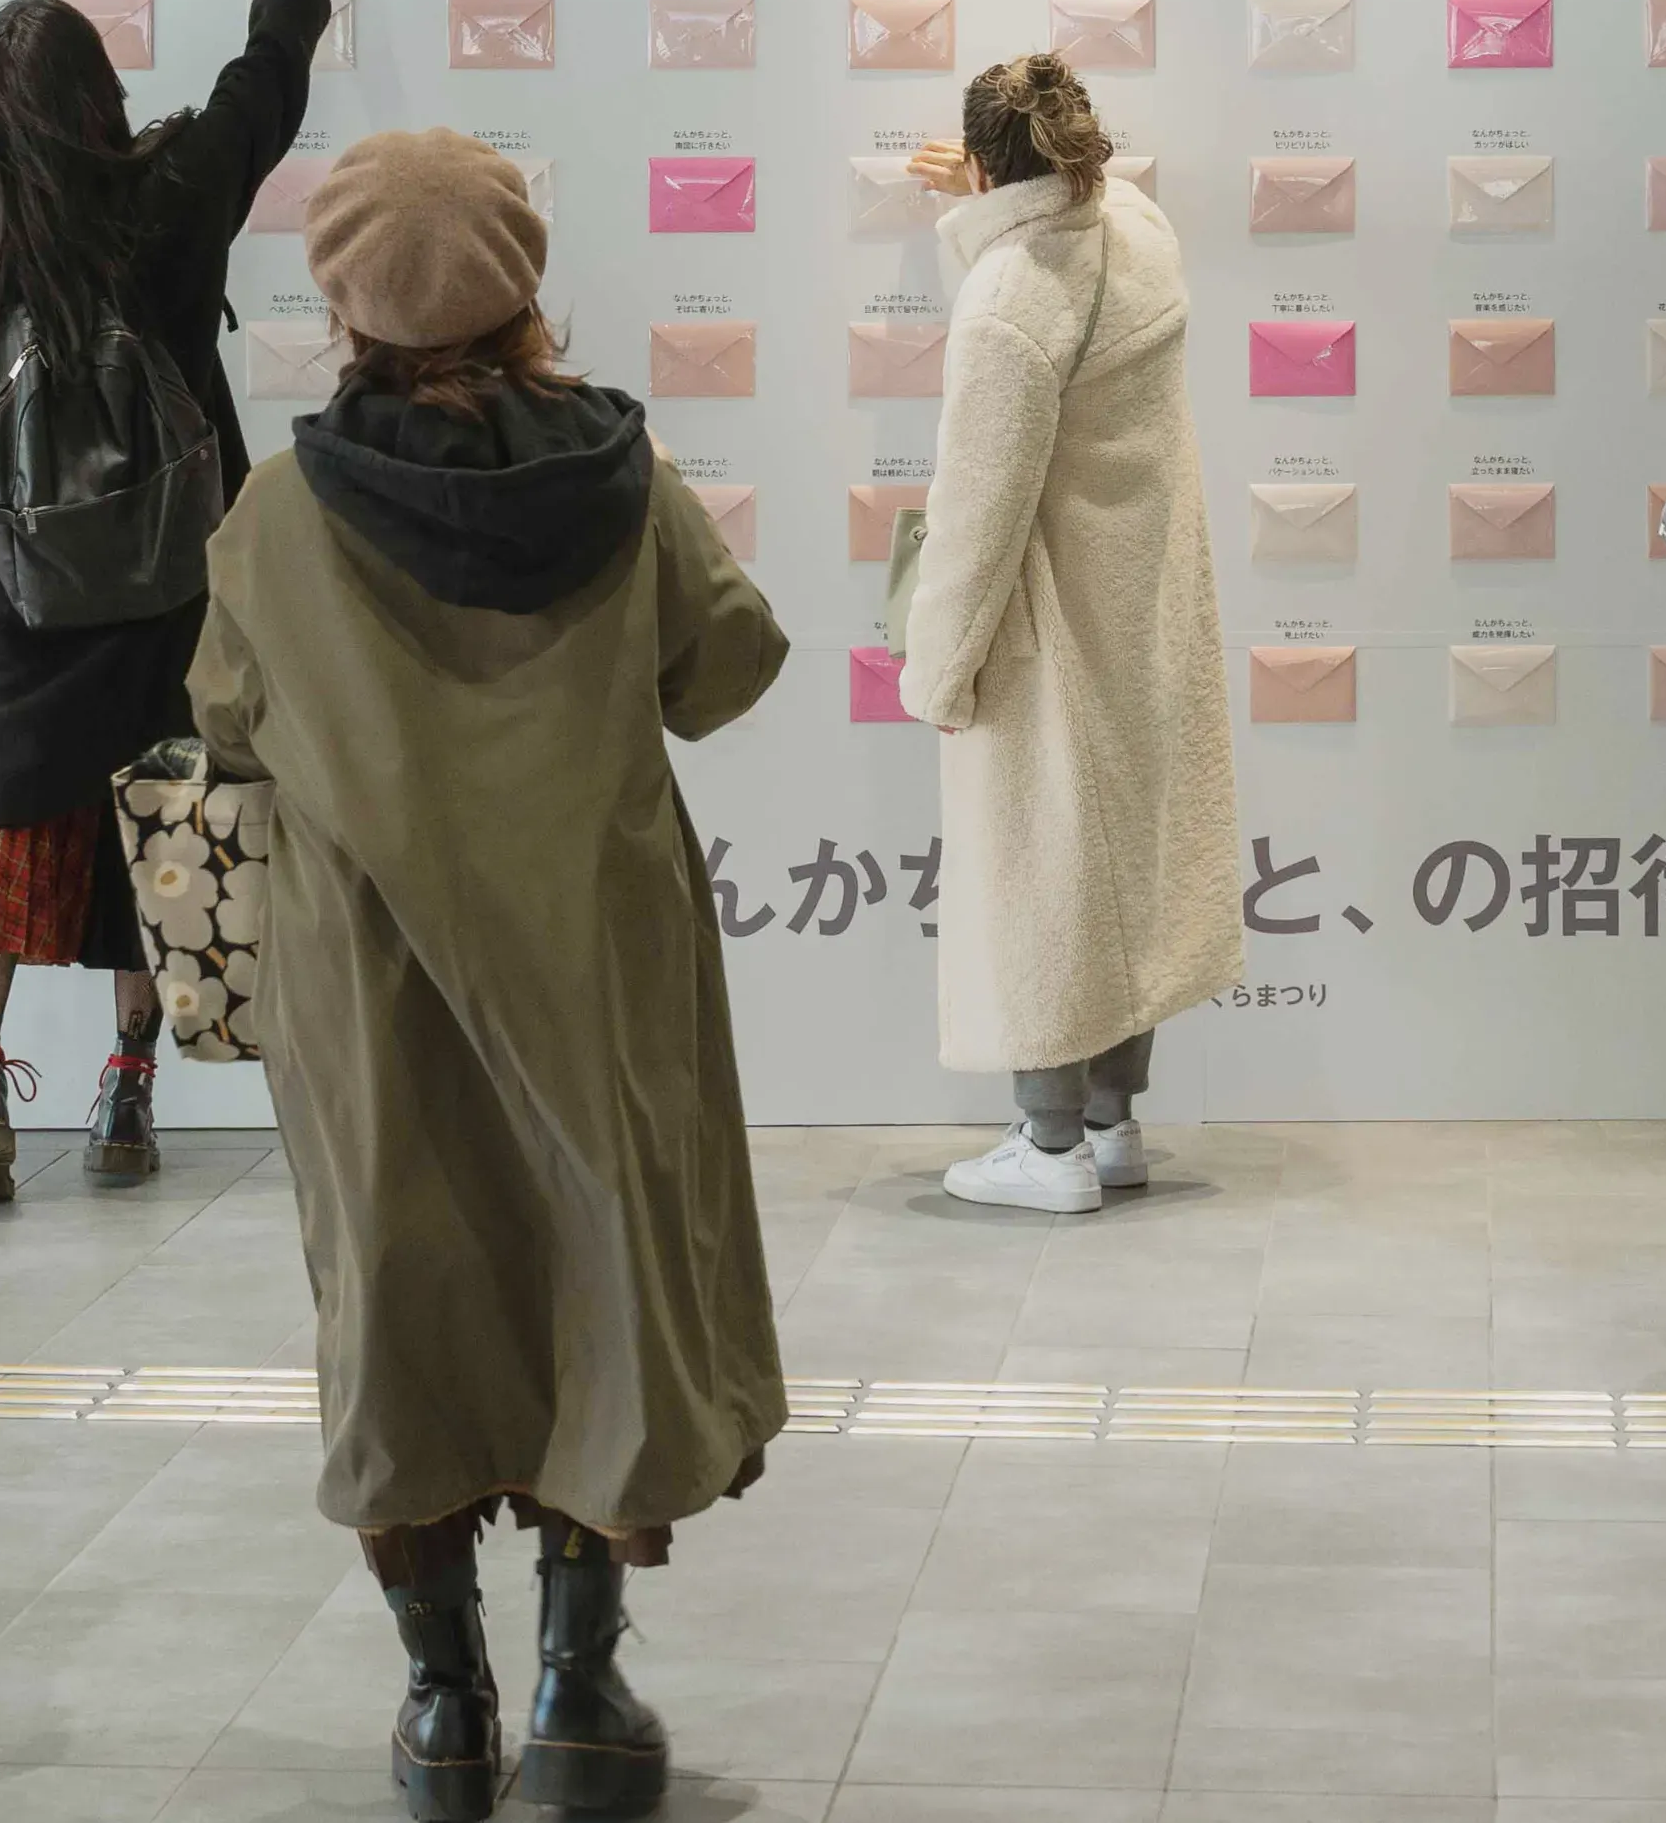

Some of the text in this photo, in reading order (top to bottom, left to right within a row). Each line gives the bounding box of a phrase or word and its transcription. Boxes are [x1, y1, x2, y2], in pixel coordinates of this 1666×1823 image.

[473, 130, 531, 140] なんかちょっと、
[673, 130, 732, 140] なんかちょっと、
[1273, 130, 1331, 139] なんかちょっと、
[1472, 129, 1530, 139] なんかちょっと、
[675, 141, 730, 151] 南国に行きたい
[673, 294, 732, 304] なんかちょっと、
[874, 294, 932, 303] なんかちょっと、
[1274, 292, 1332, 302] なんかちょっと、
[1473, 292, 1531, 302] なんかちょっと、
[675, 305, 730, 314] そばに寄りたい
[864, 305, 943, 314] 旦那元気で留守がいい
[1271, 303, 1334, 313] 丁寧に暮らしたい
[1475, 303, 1530, 313] 音楽を感じたい
[673, 457, 731, 467] なんかちょっと、
[873, 457, 932, 467] なんかちょっと、
[1274, 456, 1332, 466] なんかちょっと、
[1473, 455, 1531, 465] なんかちょっと、
[1471, 466, 1537, 475] 立ったまま寝たい
[1275, 620, 1332, 630] なんかちょっと、
[1475, 619, 1532, 628] なんかちょっと、
[1284, 631, 1325, 640] 見上げたい
[1470, 629, 1535, 639] 能力を発揮したい
